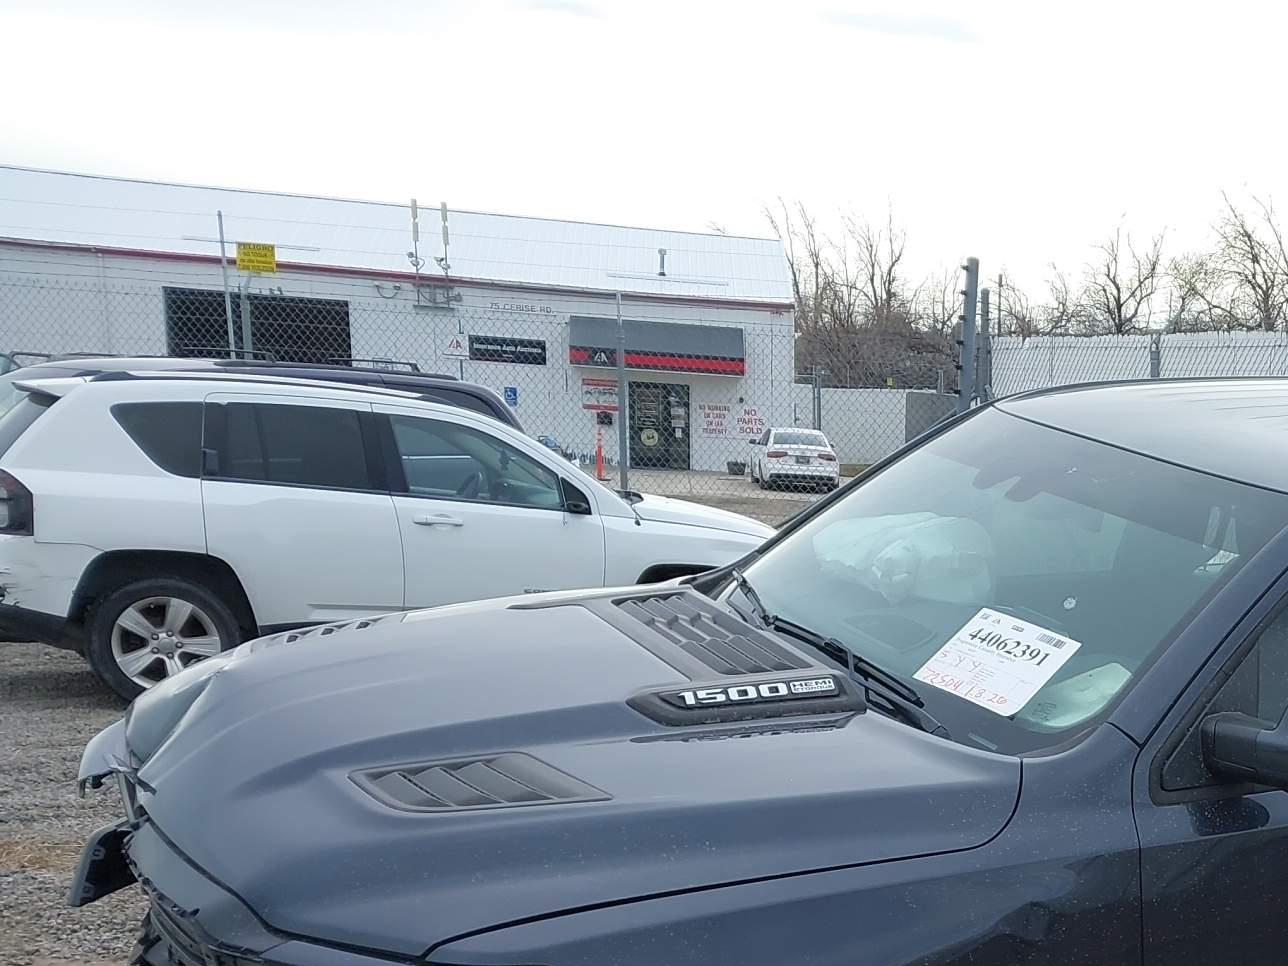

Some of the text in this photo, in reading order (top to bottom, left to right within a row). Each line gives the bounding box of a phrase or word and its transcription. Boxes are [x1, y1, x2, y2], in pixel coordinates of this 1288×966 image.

[744, 408, 757, 416] NO
[736, 417, 764, 425] PARTS
[739, 427, 763, 435] SOLD
[968, 628, 1051, 666] 44062391
[677, 679, 832, 706] 1500 HEMI
